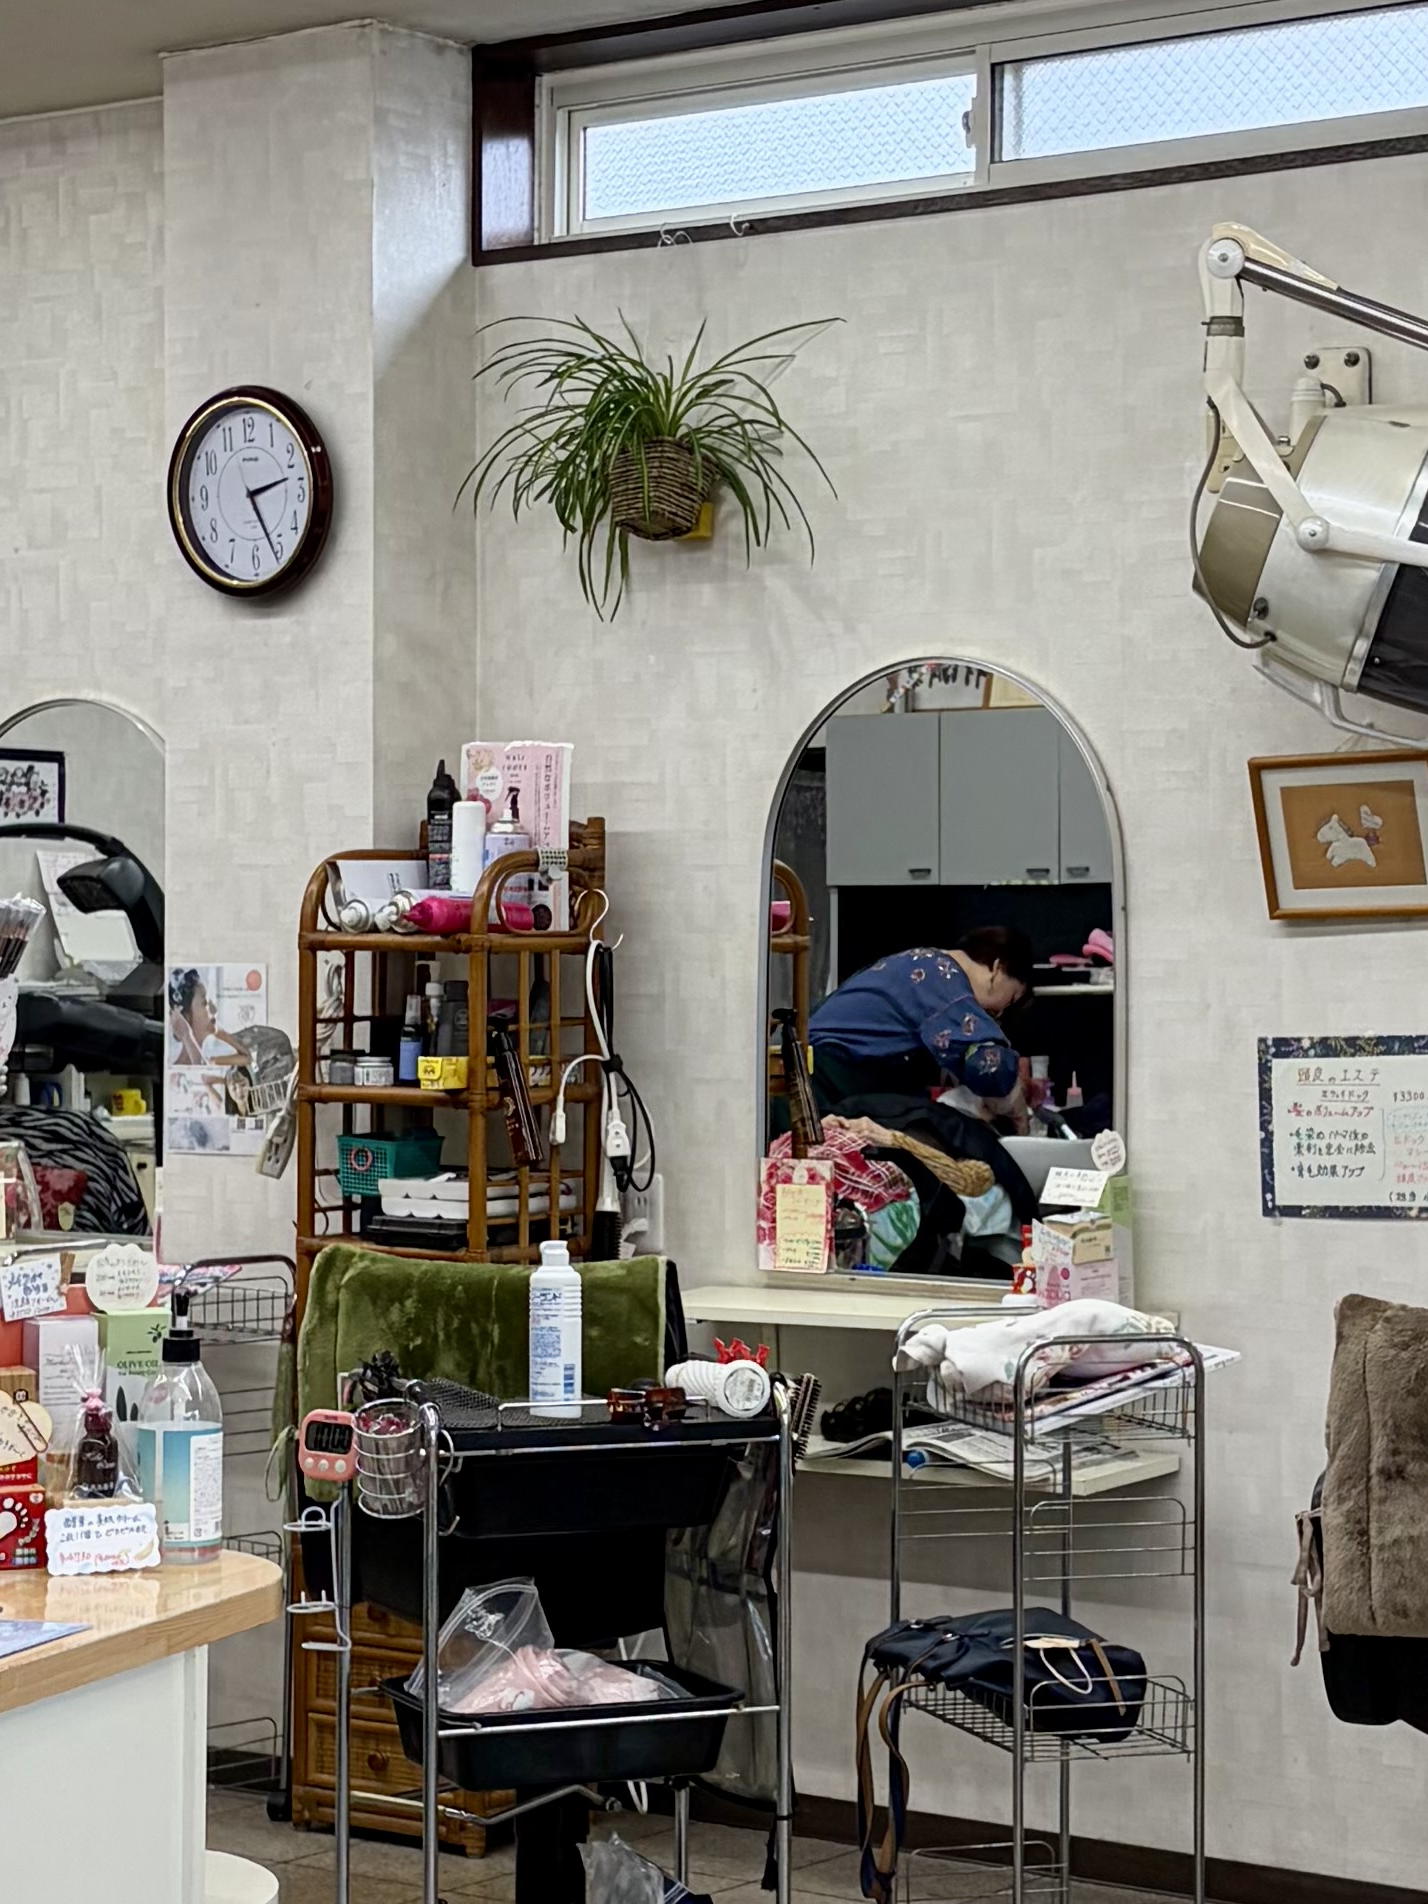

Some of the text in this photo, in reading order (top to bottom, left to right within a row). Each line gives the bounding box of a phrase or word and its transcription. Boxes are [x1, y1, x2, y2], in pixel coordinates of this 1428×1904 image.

[223, 427, 233, 452] 11
[243, 417, 255, 443] 12
[270, 423, 274, 447] 1
[206, 450, 217, 475] 10
[286, 443, 295, 468] 2
[200, 485, 209, 511] 9
[298, 478, 306, 502] 3
[210, 518, 218, 543] 8
[291, 510, 298, 535] 4
[229, 539, 236, 563] 7
[252, 545, 260, 570] 6
